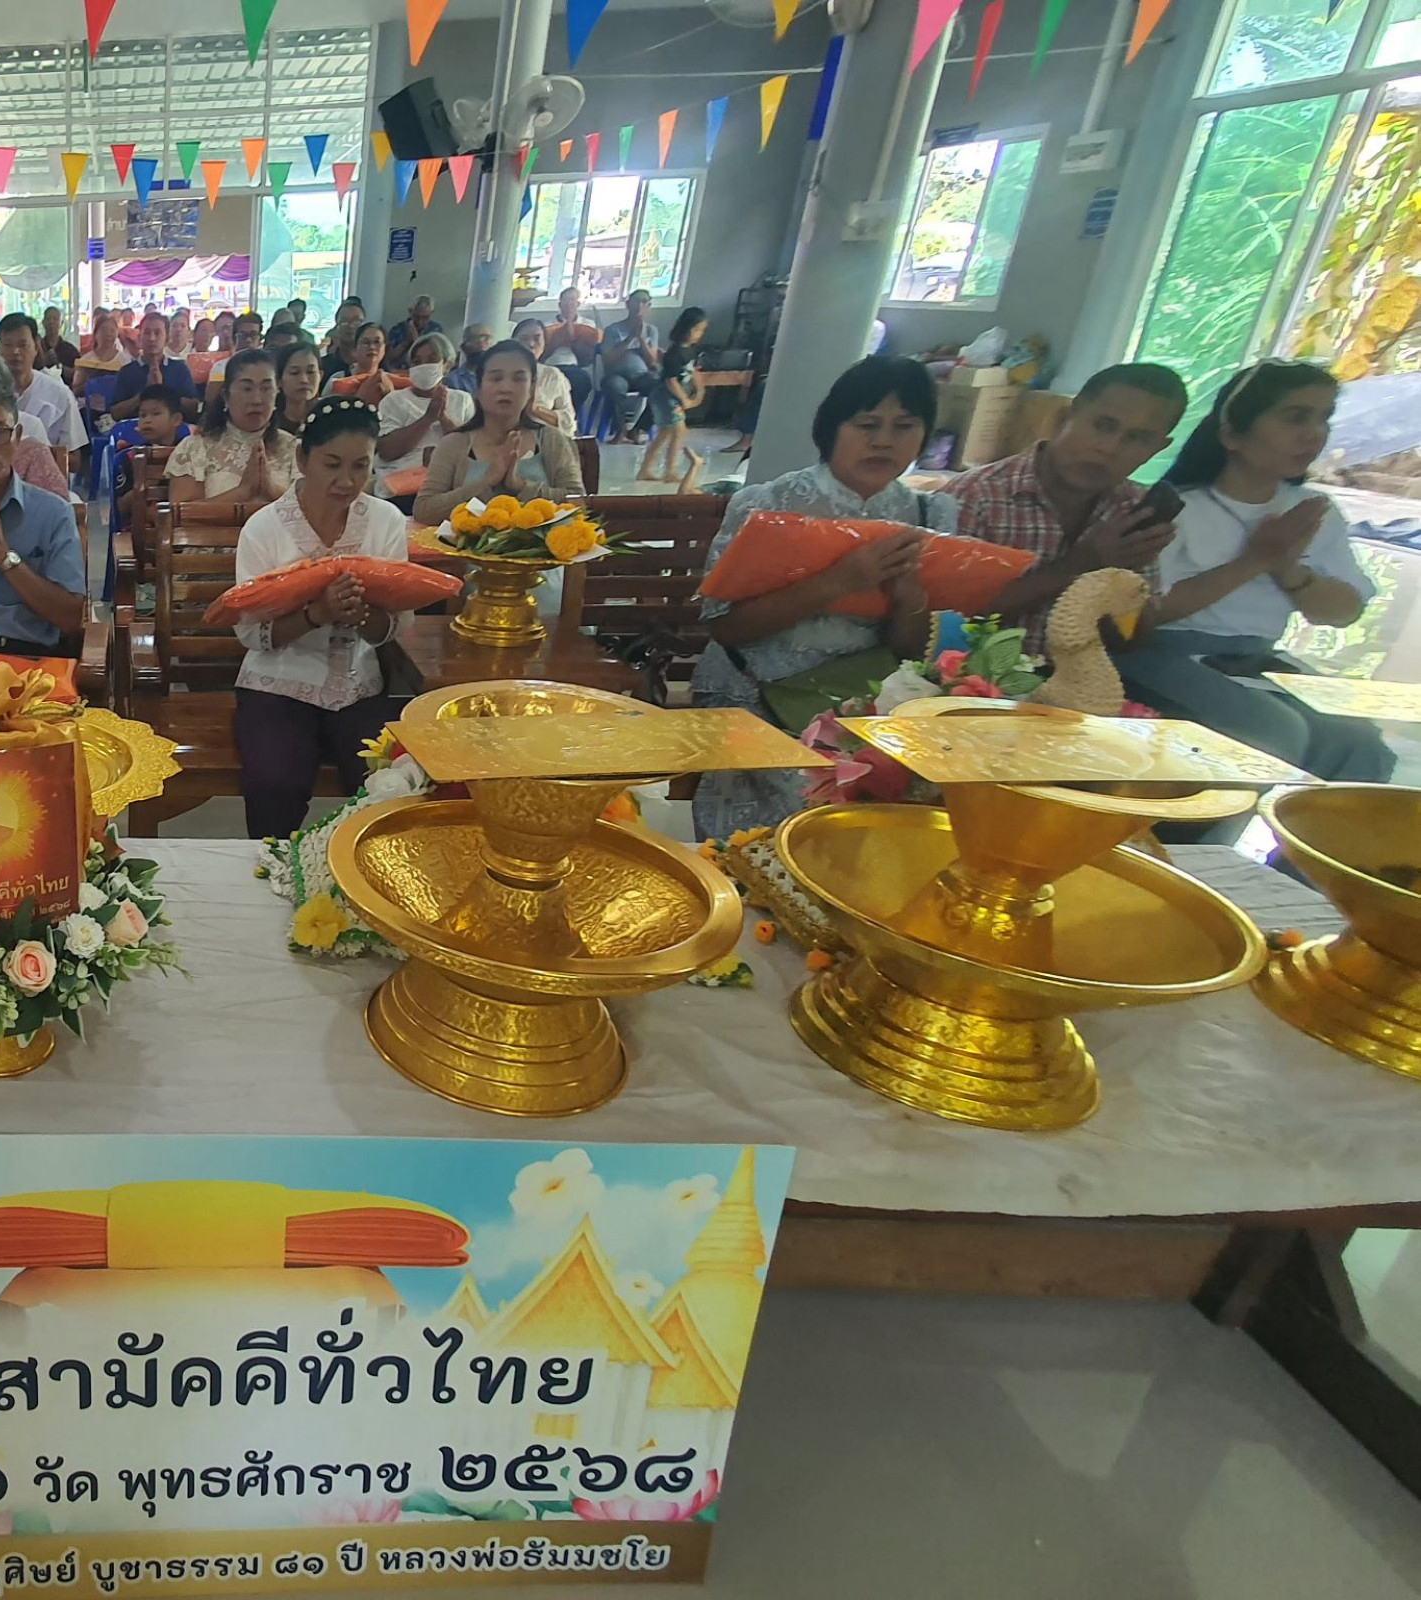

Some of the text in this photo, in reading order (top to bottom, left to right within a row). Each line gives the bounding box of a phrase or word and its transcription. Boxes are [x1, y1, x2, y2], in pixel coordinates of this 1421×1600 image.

[33, 1456, 99, 1503] วัด
[118, 1450, 412, 1518] พุทธศักราช
[439, 1444, 697, 1493] ๒๕๖๘
[93, 1553, 259, 1593] บูชาธรรม
[276, 1555, 324, 1575] ๘๑
[341, 1543, 365, 1572] ปี
[380, 1536, 667, 1571] หลวงพ่อธัมมชโย
